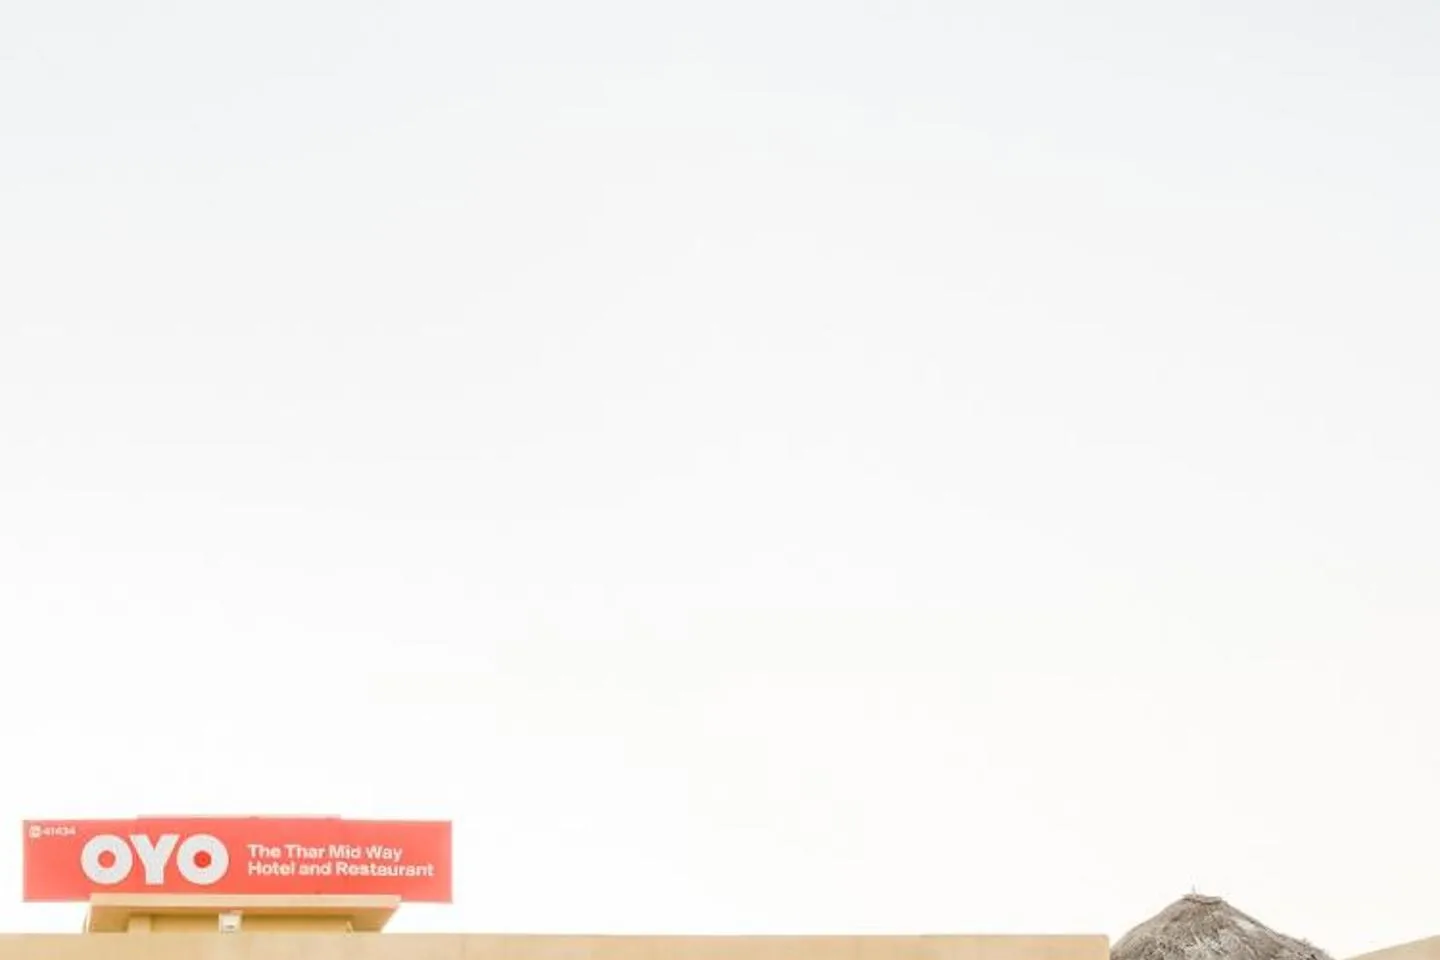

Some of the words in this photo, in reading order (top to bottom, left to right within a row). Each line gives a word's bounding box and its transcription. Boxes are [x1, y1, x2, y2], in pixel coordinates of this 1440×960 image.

[80, 833, 229, 885] OYO
[248, 844, 281, 859] The
[284, 844, 325, 859] Thar
[329, 844, 361, 860] Mid
[365, 845, 403, 862] Way
[247, 861, 295, 877] Hotel
[298, 862, 332, 876] and
[335, 862, 435, 877] Restaurant
